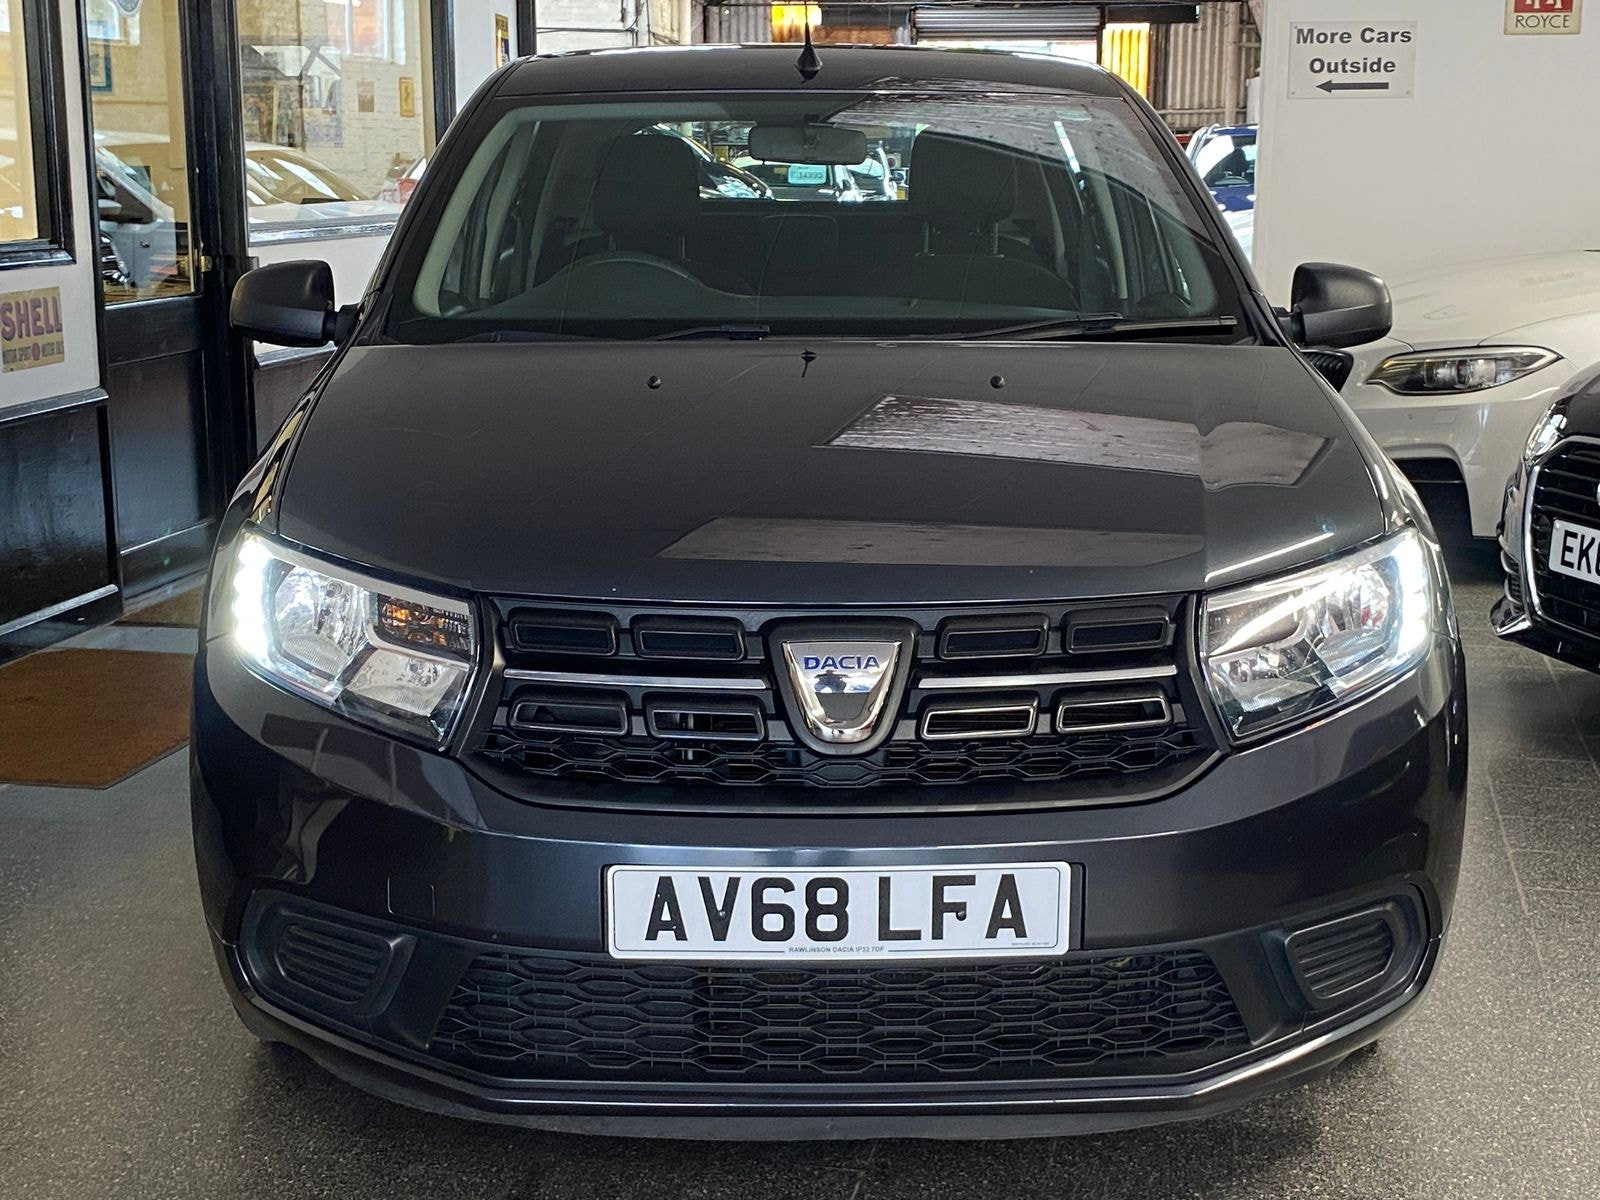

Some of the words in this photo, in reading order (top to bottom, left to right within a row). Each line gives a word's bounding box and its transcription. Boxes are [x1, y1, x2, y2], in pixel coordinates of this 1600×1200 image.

[1515, 14, 1571, 29] ROYCE
[1296, 27, 1352, 44] More
[1360, 27, 1412, 43] Cars
[1309, 57, 1396, 74] Outside
[1, 296, 63, 341] SHELL
[1560, 529, 1600, 577] EK
[803, 655, 881, 670] DACIA
[645, 876, 850, 942] AV68
[877, 873, 1028, 941] LFA
